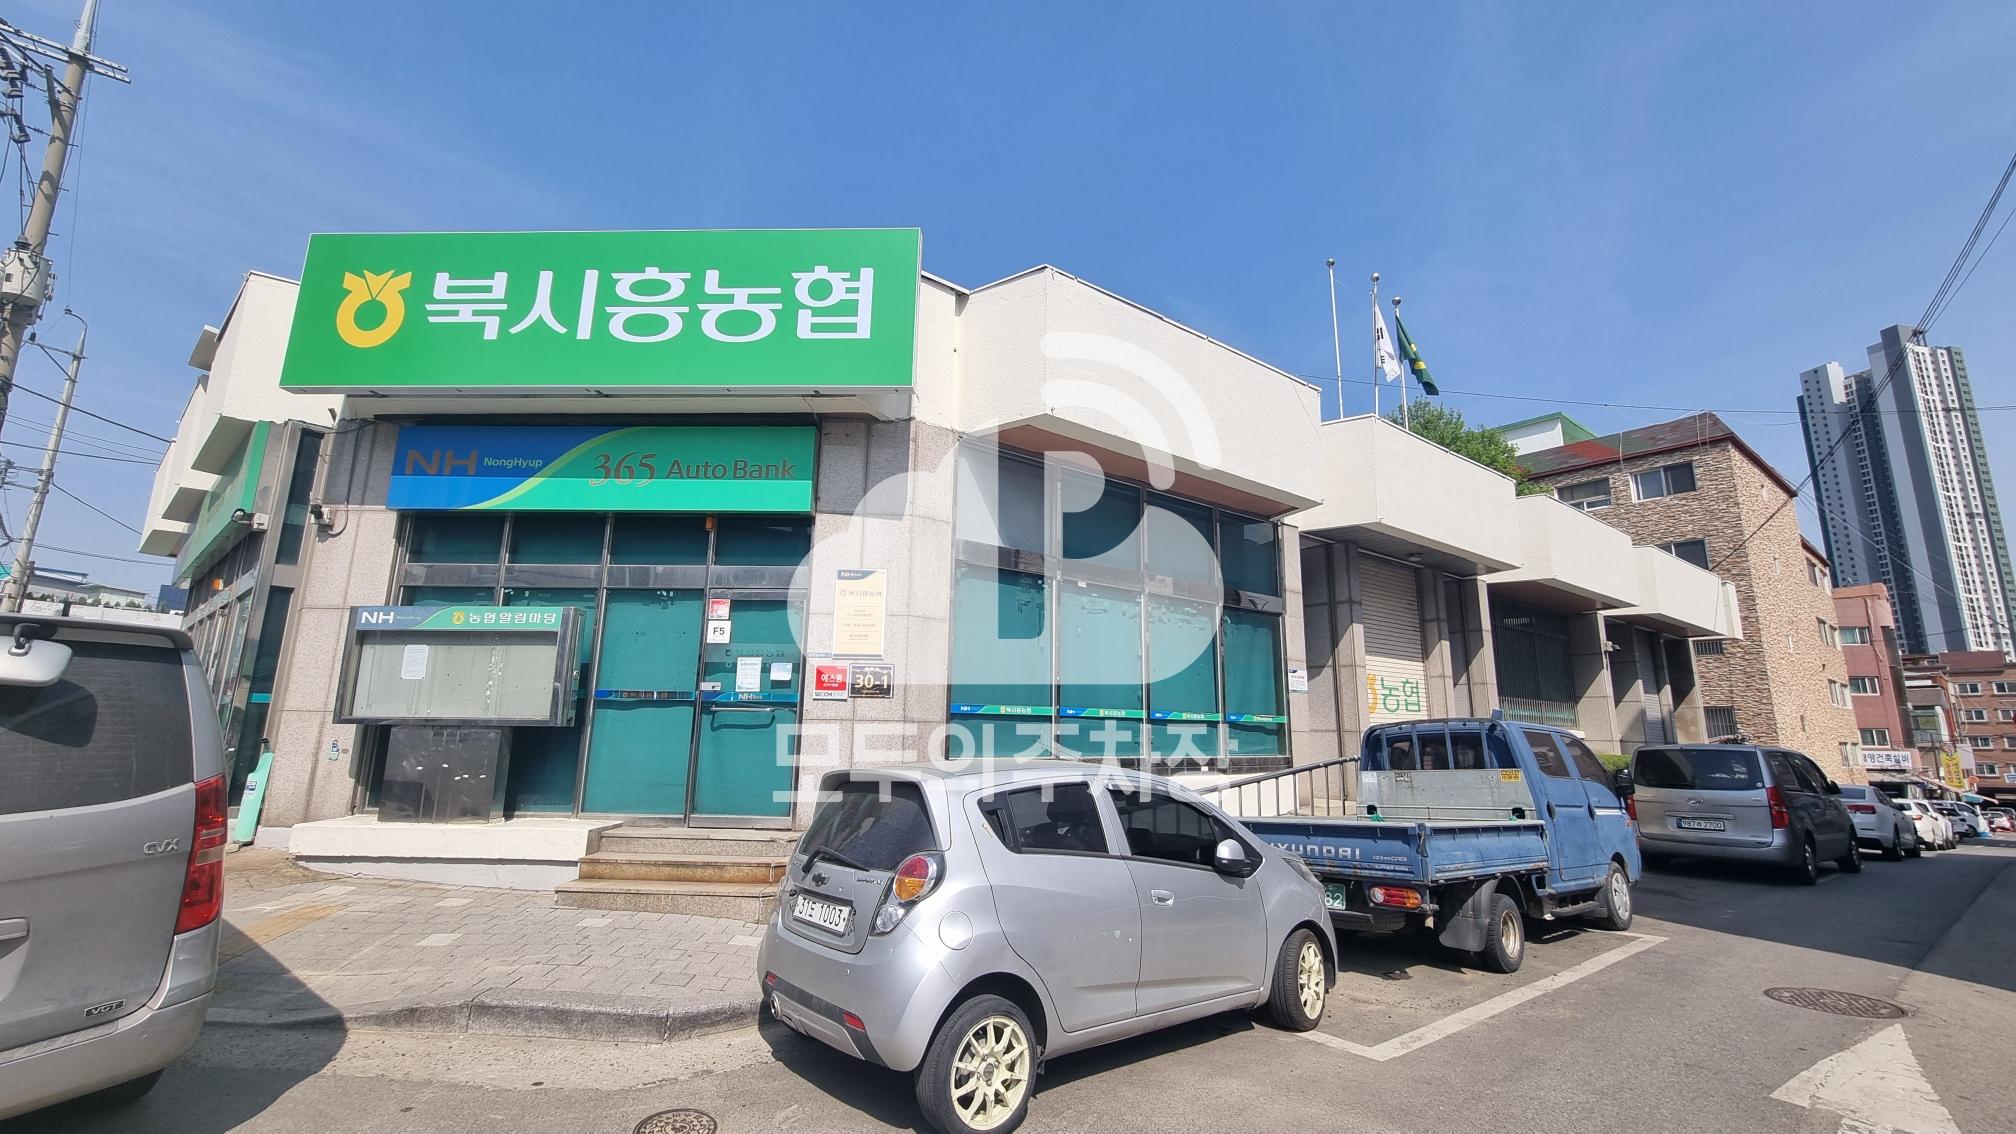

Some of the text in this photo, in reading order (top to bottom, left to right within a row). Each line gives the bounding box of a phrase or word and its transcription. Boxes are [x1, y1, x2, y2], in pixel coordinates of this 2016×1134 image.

[426, 265, 874, 343] 북시흥농협
[404, 449, 543, 475] NH NongHyup
[588, 451, 796, 488] 365 Auto Bank
[361, 611, 394, 624] NH
[713, 627, 725, 635] F5
[854, 672, 889, 688] 30-1
[1381, 677, 1421, 712] 농협
[143, 837, 180, 855] CVX
[1269, 843, 1360, 860] YUNDAI
[818, 904, 843, 927] 1003
